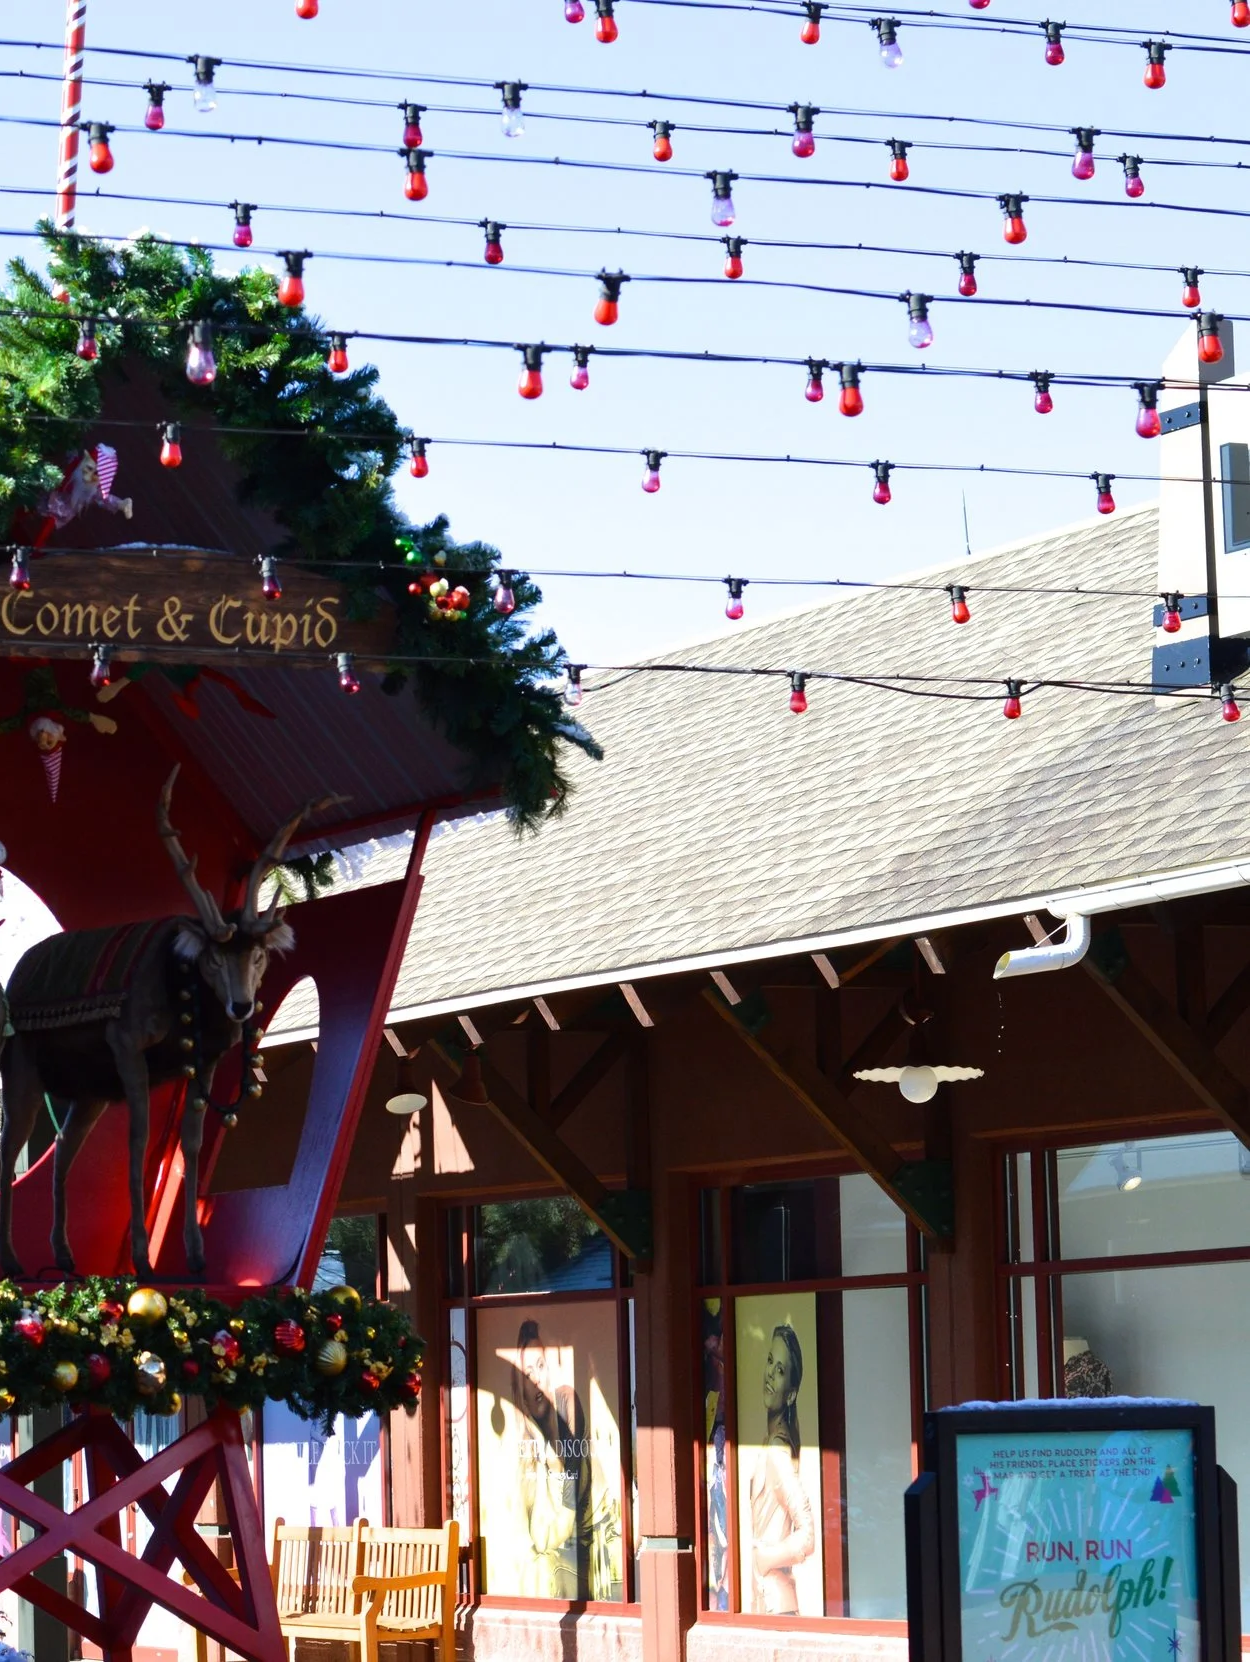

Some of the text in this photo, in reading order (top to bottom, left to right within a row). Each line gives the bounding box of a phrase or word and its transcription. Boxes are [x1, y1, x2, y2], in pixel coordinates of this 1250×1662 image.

[1, 590, 339, 652] Comet & Cupid
[993, 1446, 1152, 1458] HELP US FIND RUDOLPH AND ALL OF
[990, 1461, 1004, 1469] HIS
[1048, 1459, 1076, 1468] PLACE
[1079, 1458, 1120, 1467] STICKERS
[1123, 1458, 1136, 1466] ON
[1139, 1457, 1156, 1465] THE
[1068, 1469, 1096, 1478] TREAT
[1113, 1468, 1131, 1477] THE
[1026, 1539, 1133, 1565] RUN, RUN
[1000, 1556, 1174, 1642] Rudolph!
